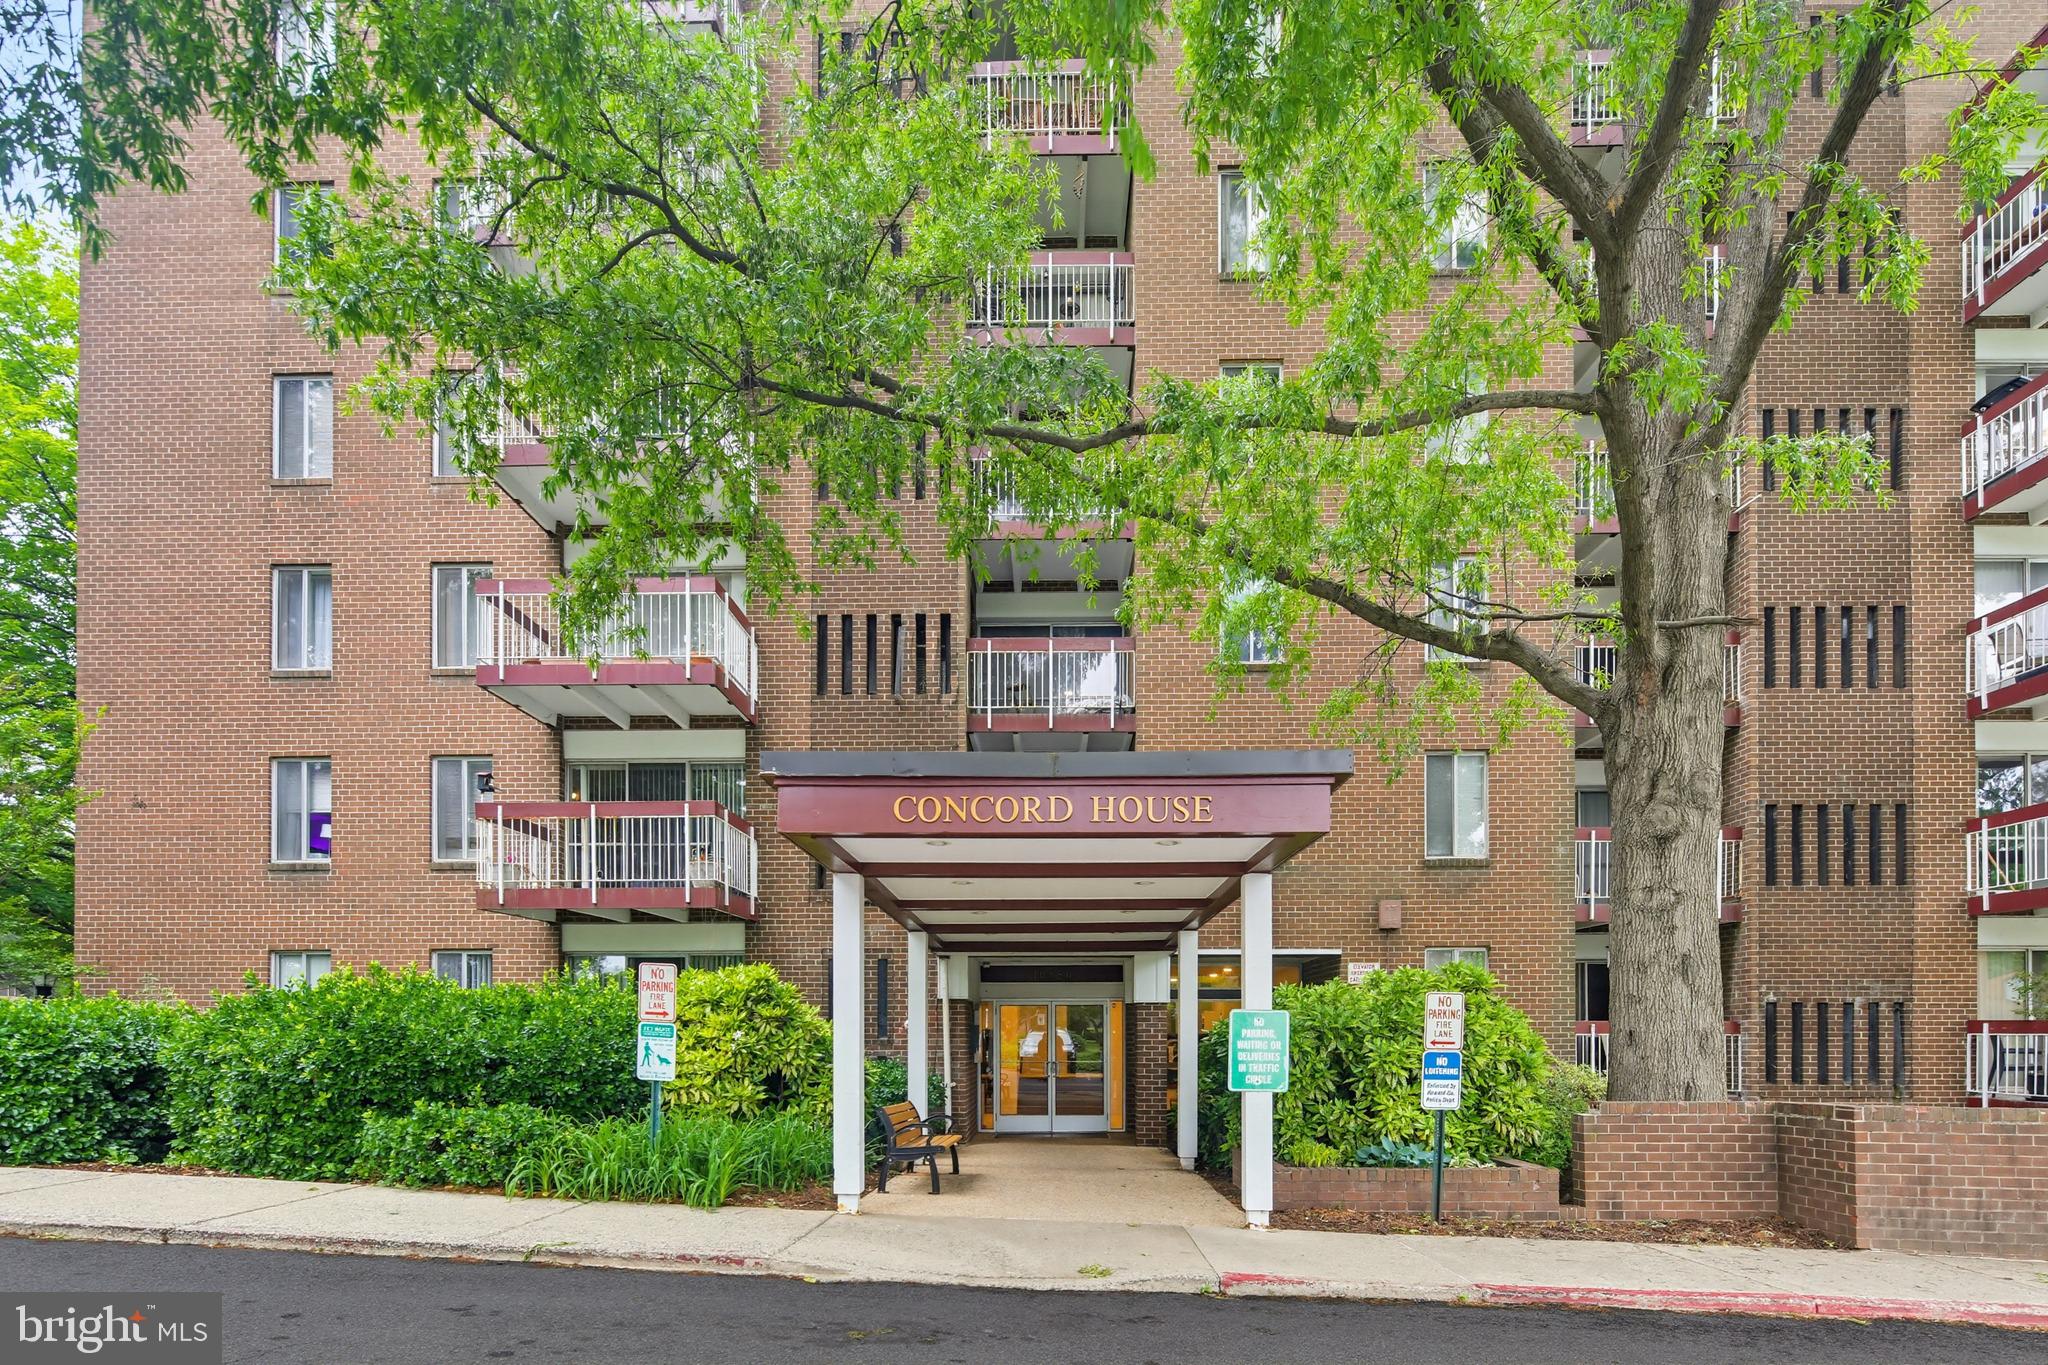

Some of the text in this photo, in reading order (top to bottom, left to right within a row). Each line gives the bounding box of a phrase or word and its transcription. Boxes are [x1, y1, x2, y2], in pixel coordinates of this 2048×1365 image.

[892, 795, 1215, 824] CONCORD HOUSE
[651, 968, 665, 980] NO
[641, 981, 674, 993] PARKING
[650, 993, 665, 1001] FIRE
[1437, 996, 1452, 1007] NO
[649, 1002, 666, 1010] LANE
[1428, 1009, 1461, 1020] PARKING
[1253, 1017, 1265, 1027] NO
[1436, 1021, 1452, 1029] FIRE
[1434, 1030, 1453, 1038] LANE
[1236, 1040, 1282, 1050] WAITING OR
[1237, 1051, 1281, 1061] DELIVERIES
[1436, 1056, 1448, 1067] NO
[1238, 1063, 1280, 1073] IN TRAFFIC
[1424, 1067, 1459, 1076] LOITERING
